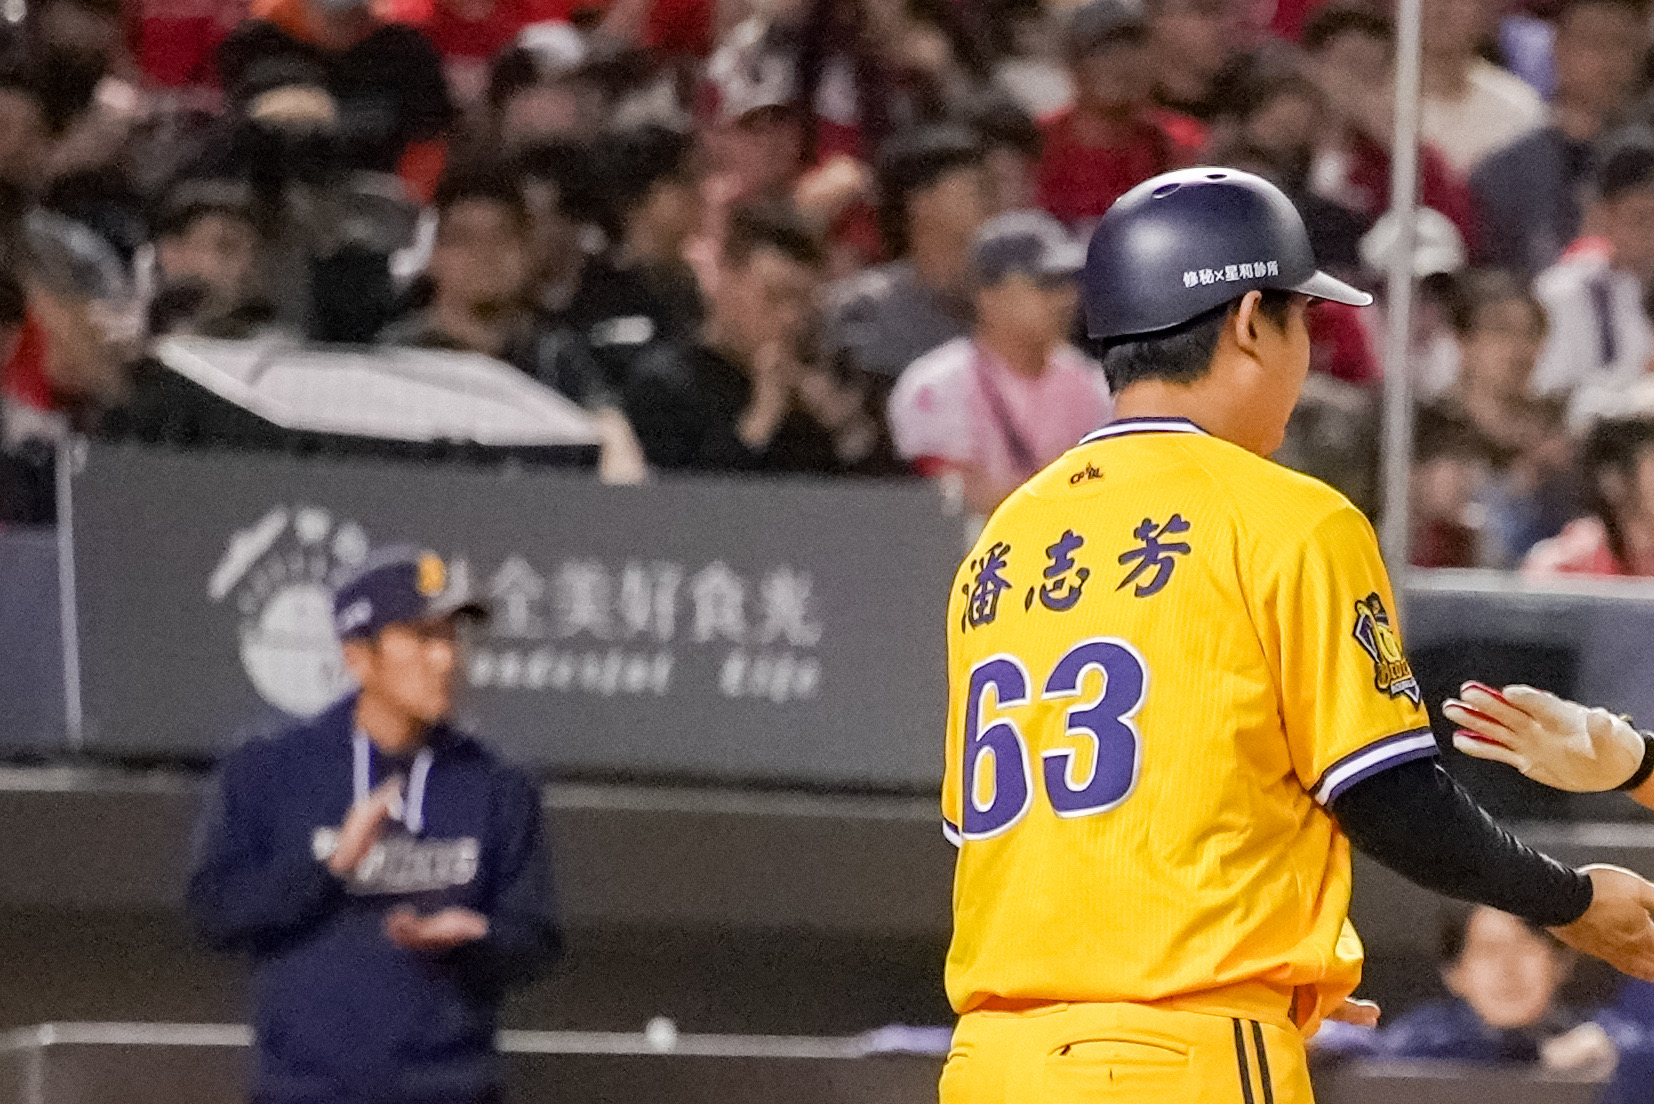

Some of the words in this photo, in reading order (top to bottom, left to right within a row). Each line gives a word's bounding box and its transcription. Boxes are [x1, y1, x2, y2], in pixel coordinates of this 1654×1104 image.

[961, 513, 1192, 634] 潘志芳
[961, 636, 1149, 841] 63
